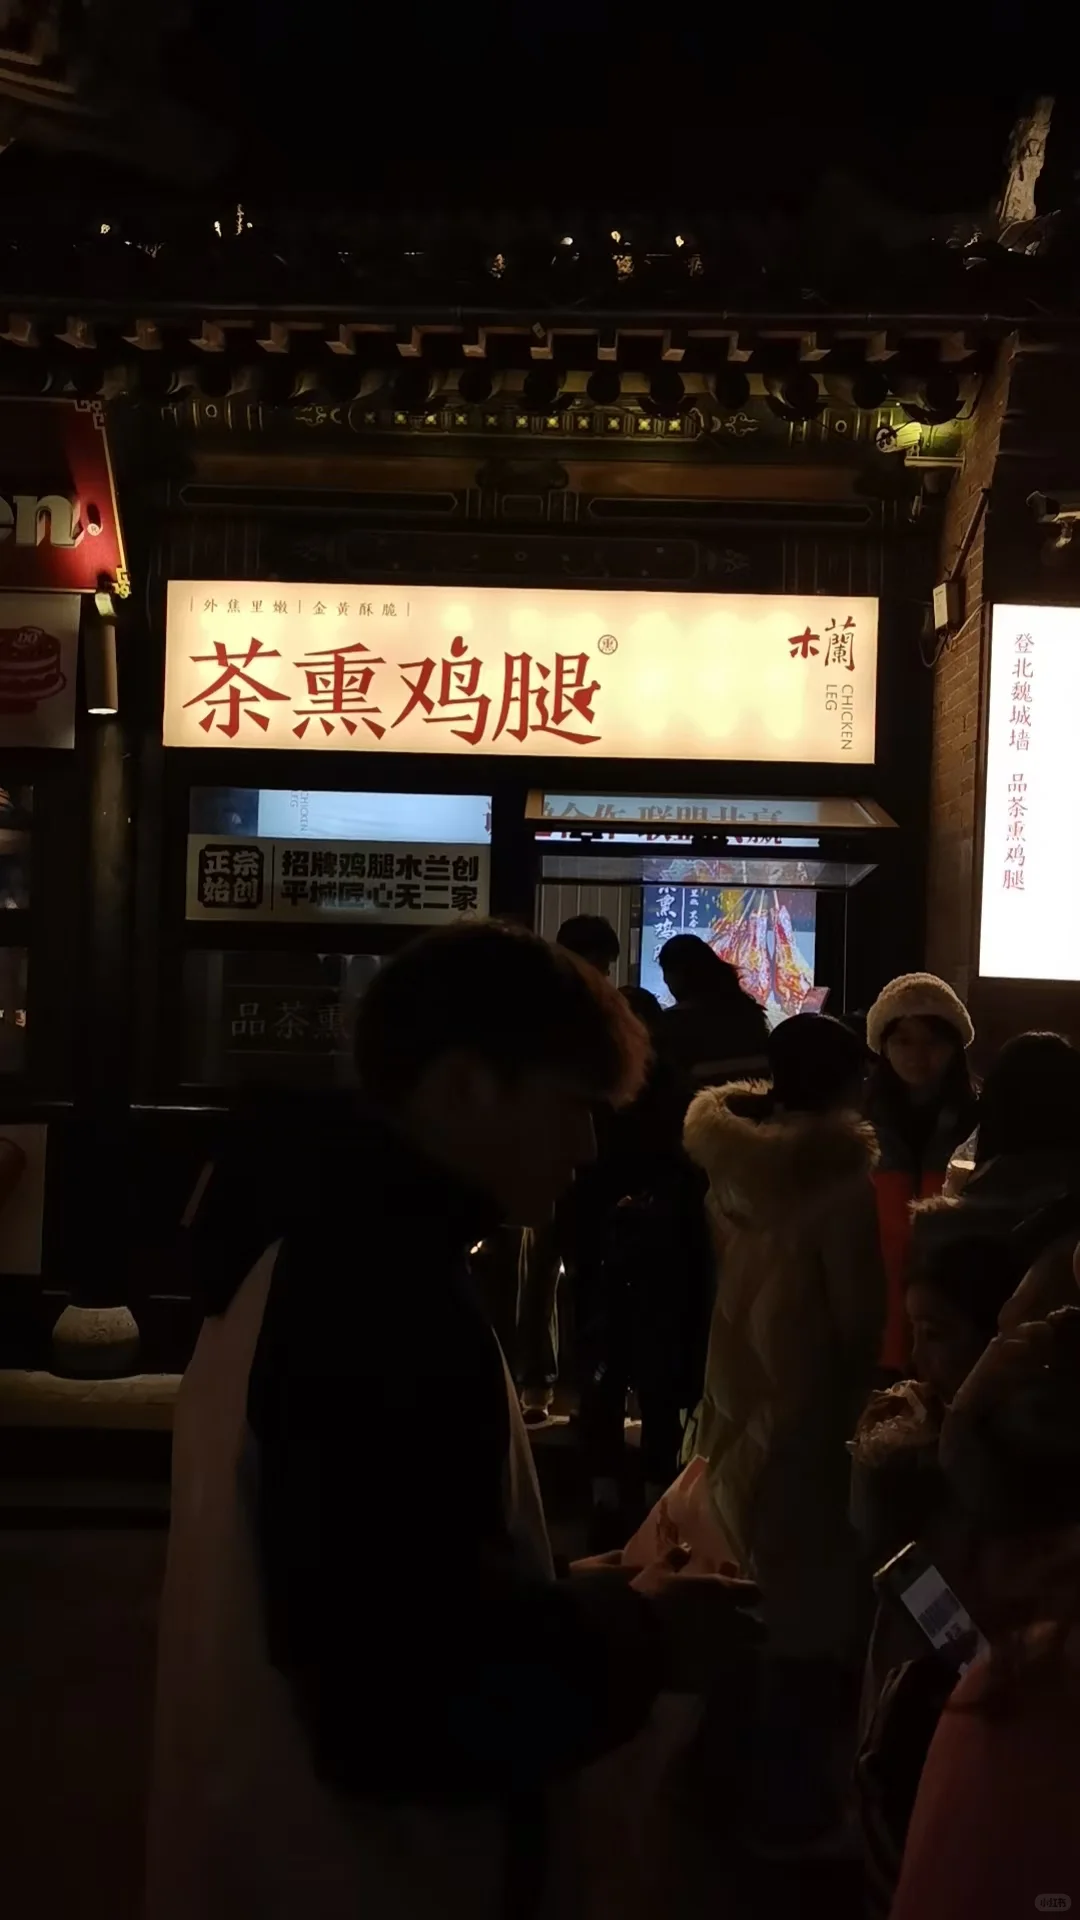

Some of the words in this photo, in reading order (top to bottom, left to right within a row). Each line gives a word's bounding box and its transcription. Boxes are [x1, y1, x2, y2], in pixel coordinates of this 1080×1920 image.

[203, 598, 288, 614] 外焦里嫩
[312, 600, 397, 617] 金黄酥脆
[182, 636, 602, 746] 茶熏鸡腿
[825, 683, 838, 711] LEG
[1009, 632, 1035, 752] 登北魏城墙
[841, 683, 854, 750] CHICKEN
[1002, 772, 1029, 891] 品茶熏鸡腿
[204, 849, 259, 876] 正宗
[281, 850, 479, 882] 招牌鸡腿木兰创
[202, 876, 258, 904] 始创
[281, 878, 478, 911] 平城匠心无二家
